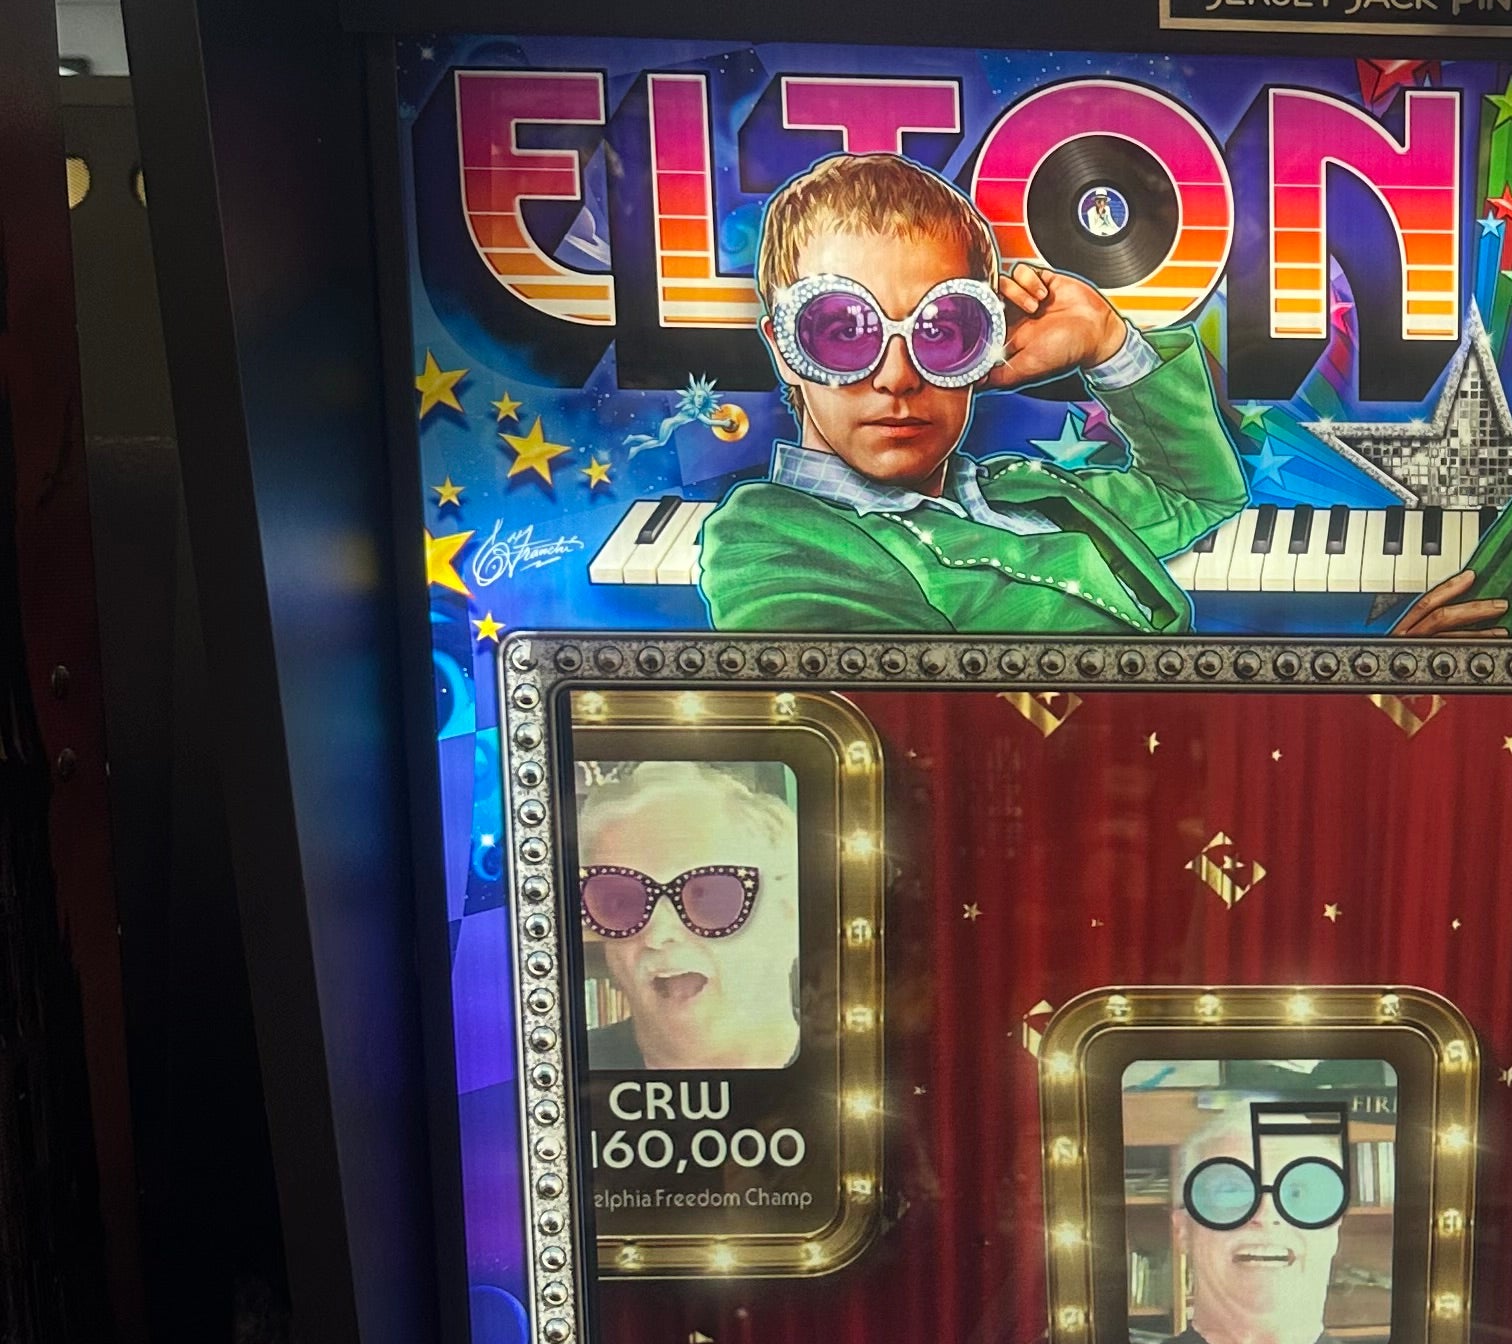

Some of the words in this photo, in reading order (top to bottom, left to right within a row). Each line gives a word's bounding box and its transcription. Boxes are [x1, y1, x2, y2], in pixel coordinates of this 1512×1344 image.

[453, 69, 1462, 341] ELTON
[608, 1081, 730, 1121] CRW
[655, 1187, 741, 1208] Freedom
[745, 1187, 813, 1210] Champ
